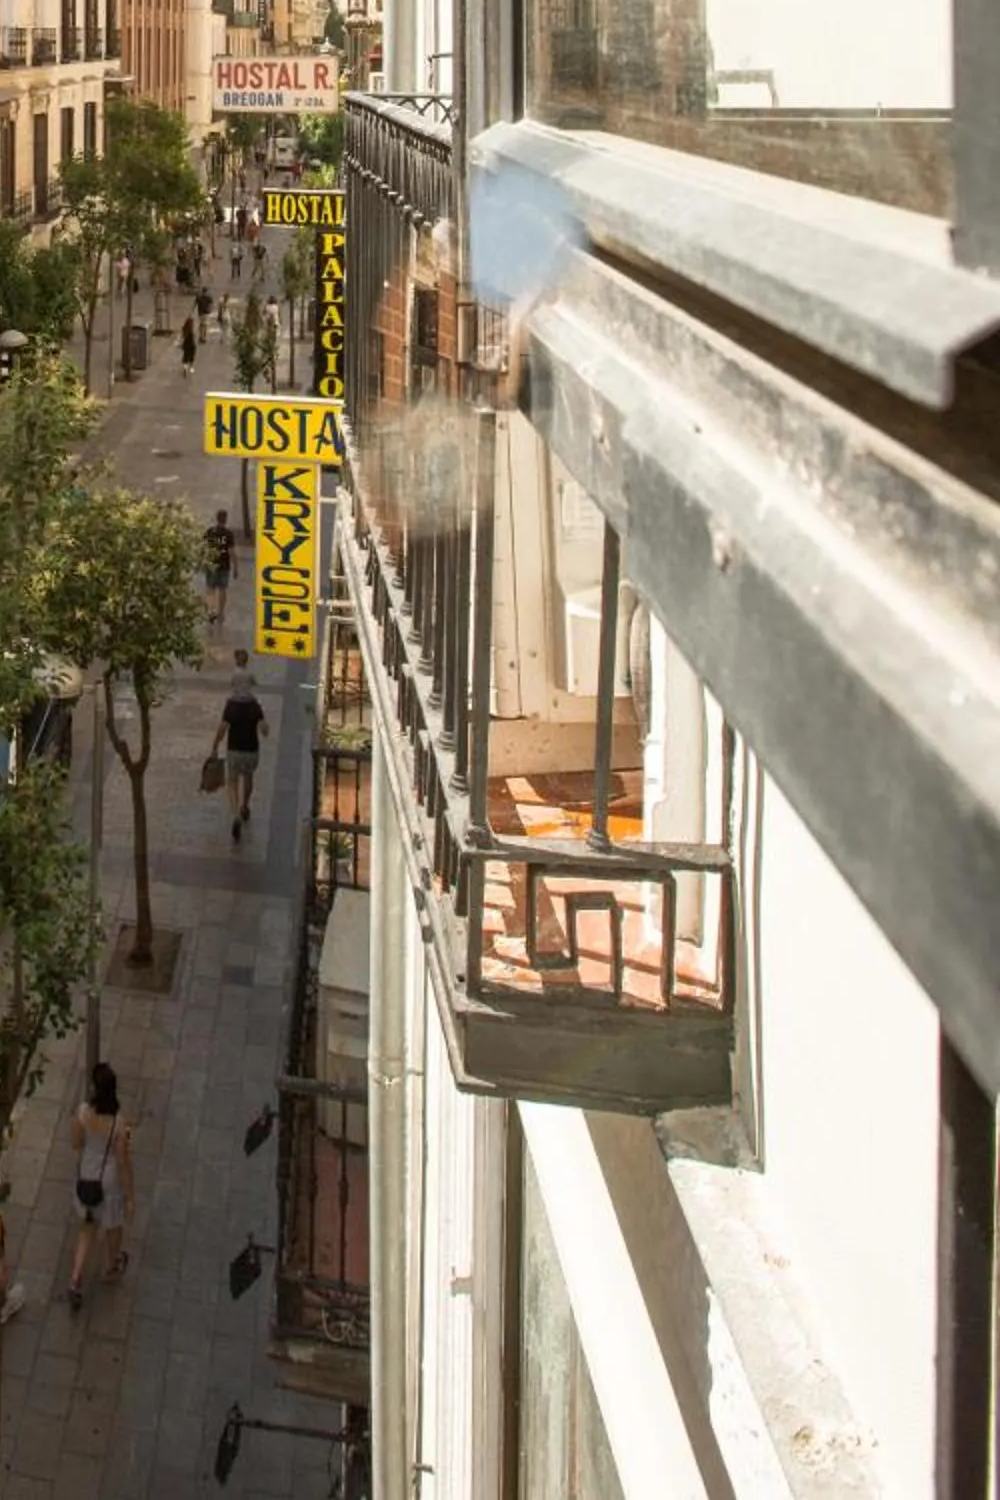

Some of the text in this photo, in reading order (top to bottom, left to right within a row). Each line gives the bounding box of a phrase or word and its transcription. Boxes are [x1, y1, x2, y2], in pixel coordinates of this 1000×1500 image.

[216, 62, 335, 90] HOSTAL R.
[266, 193, 345, 225] HOSTAL
[319, 233, 345, 398] PALACIO
[210, 403, 345, 457] HOSTA
[261, 464, 312, 634] KRYSE
